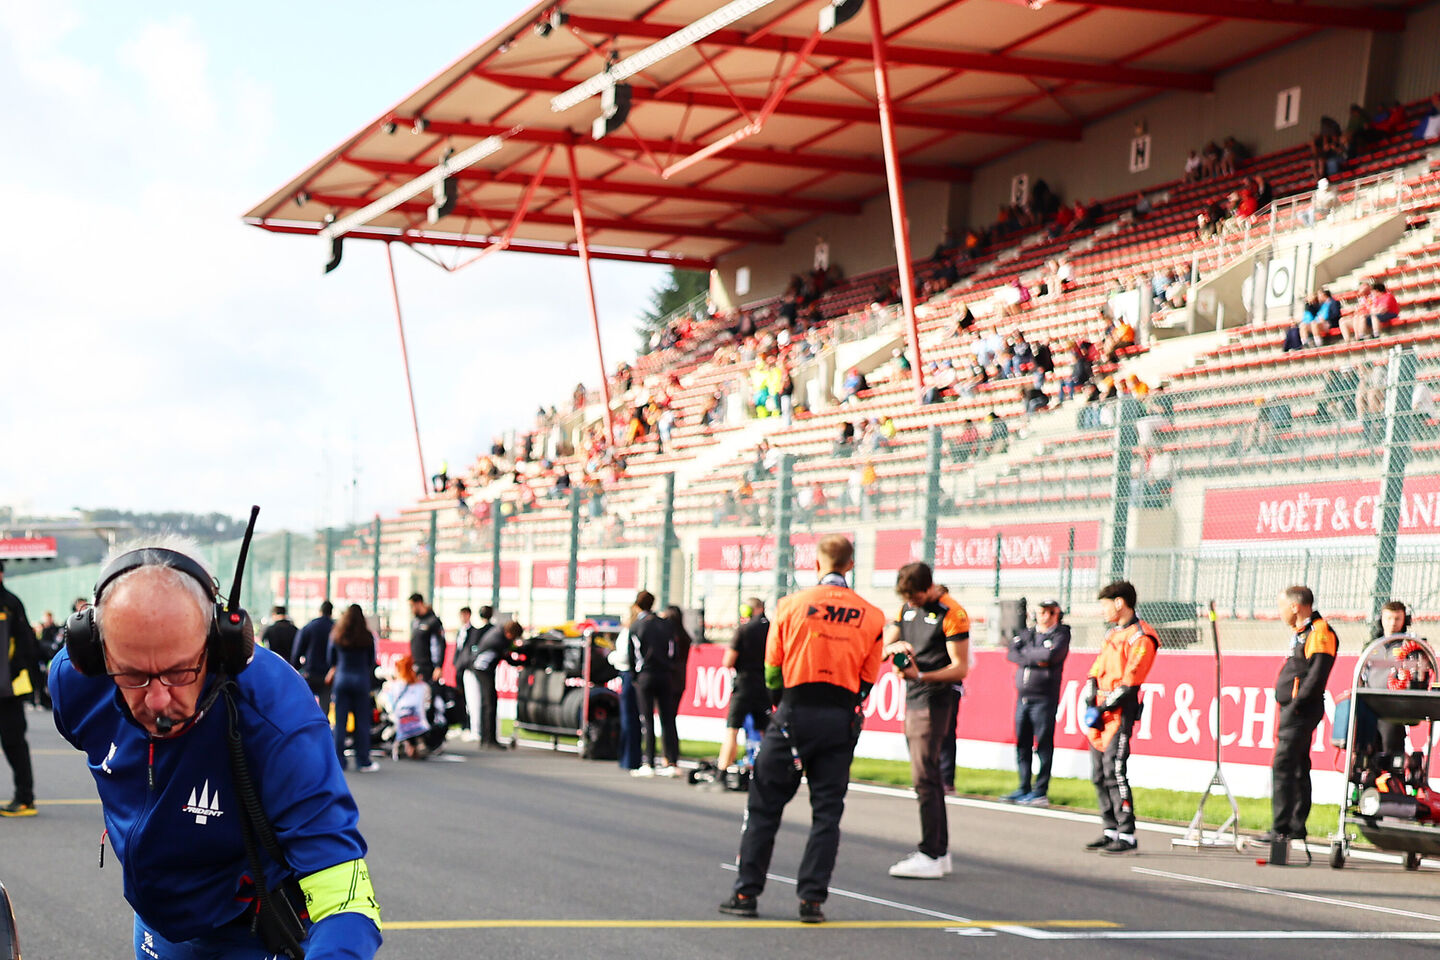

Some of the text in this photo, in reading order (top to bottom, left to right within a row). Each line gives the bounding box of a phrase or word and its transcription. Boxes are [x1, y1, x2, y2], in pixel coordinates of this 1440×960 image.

[1256, 492, 1331, 533] MOËT
[1331, 496, 1351, 531] &
[823, 605, 861, 623] MP
[693, 666, 737, 709] MO
[1168, 682, 1202, 746] &
[182, 804, 224, 817] TRIDENT
